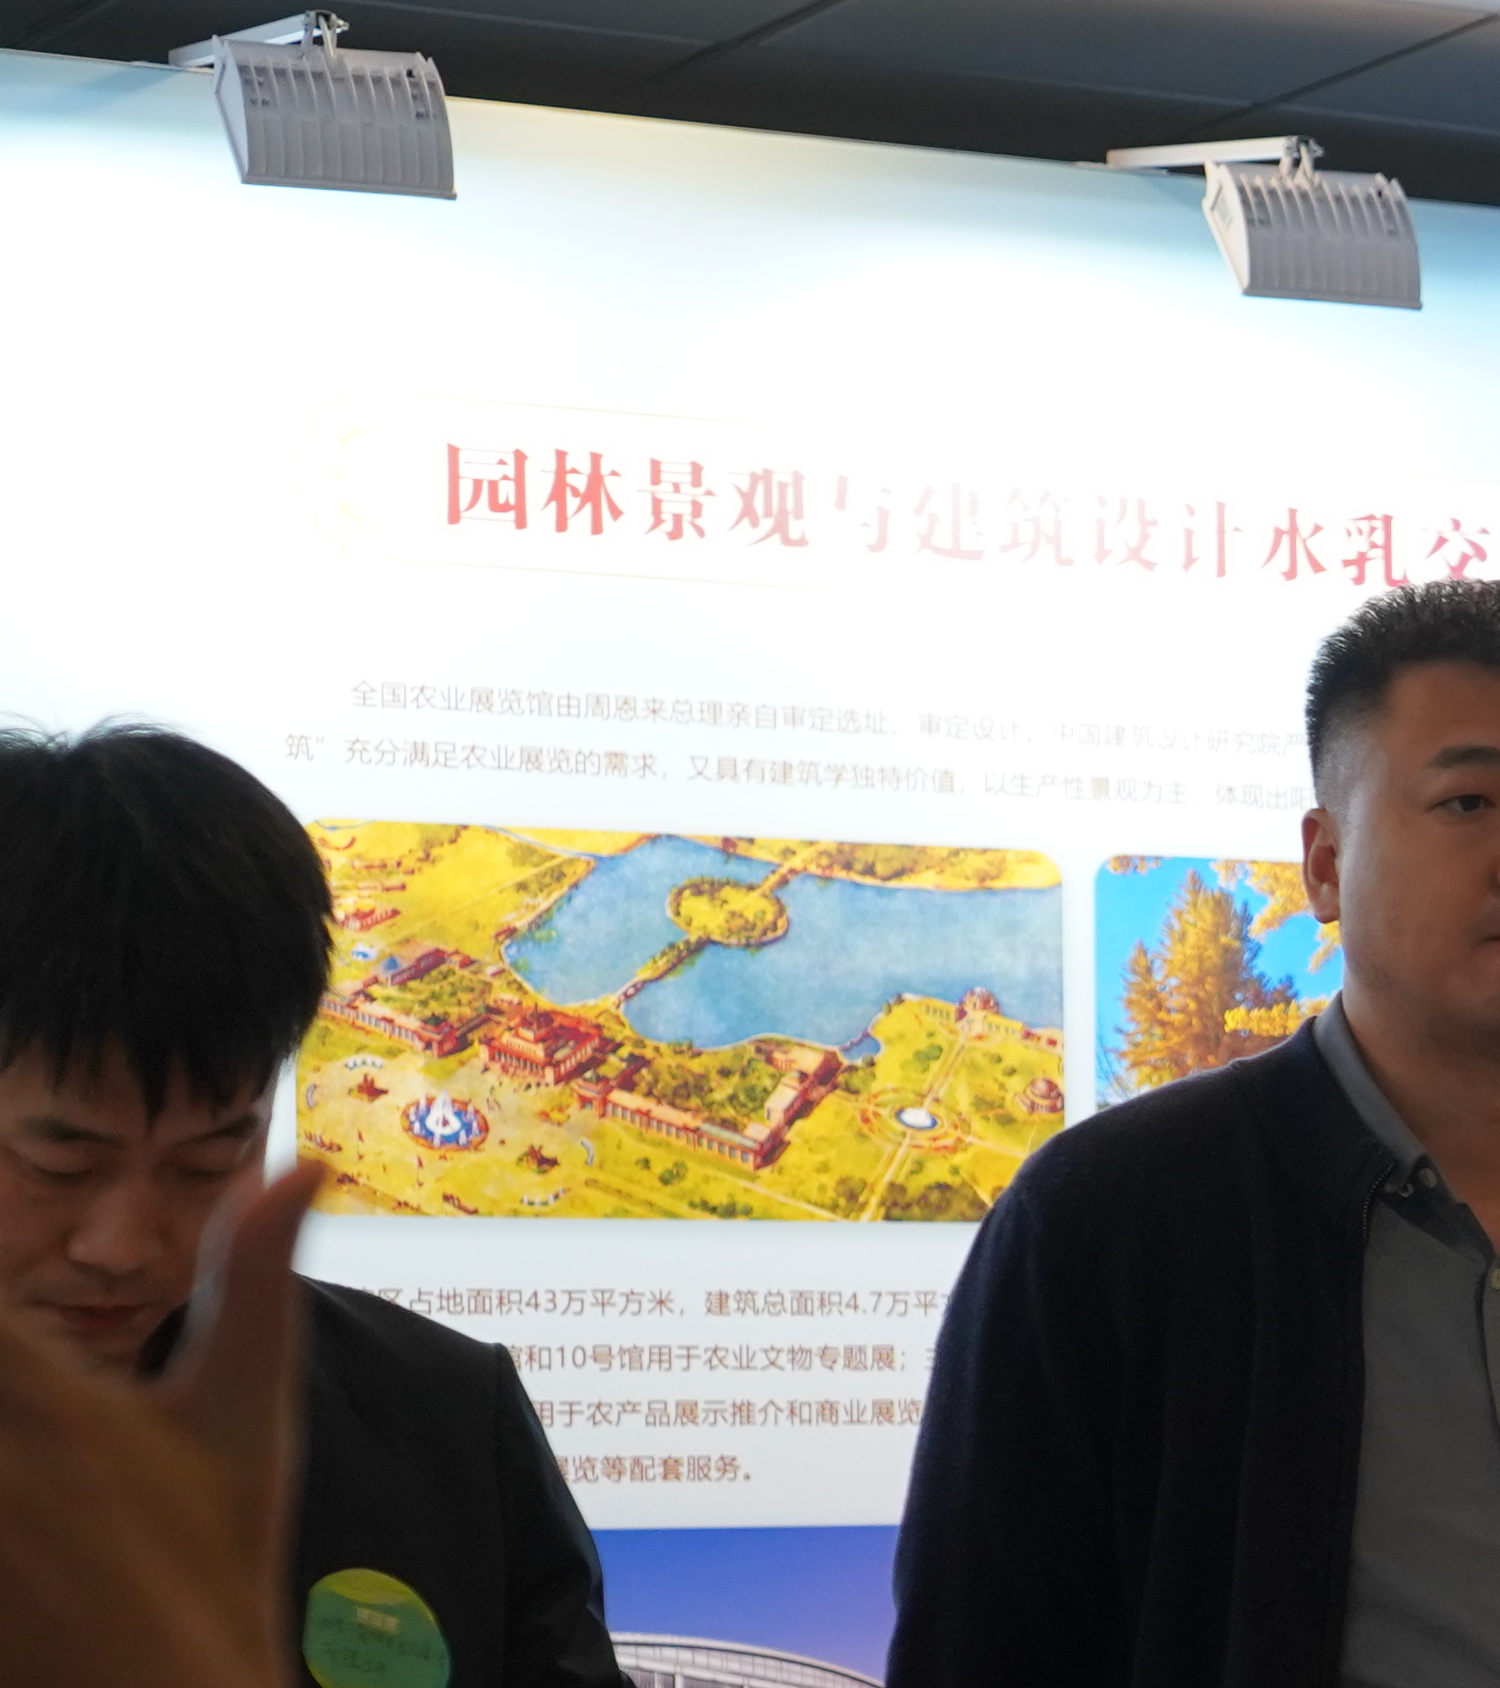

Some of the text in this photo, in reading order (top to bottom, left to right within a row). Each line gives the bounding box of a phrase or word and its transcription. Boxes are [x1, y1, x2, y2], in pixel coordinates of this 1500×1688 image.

[352, 1286, 953, 1318] 区占地面积43万平方米，建筑总面积4.7万平
